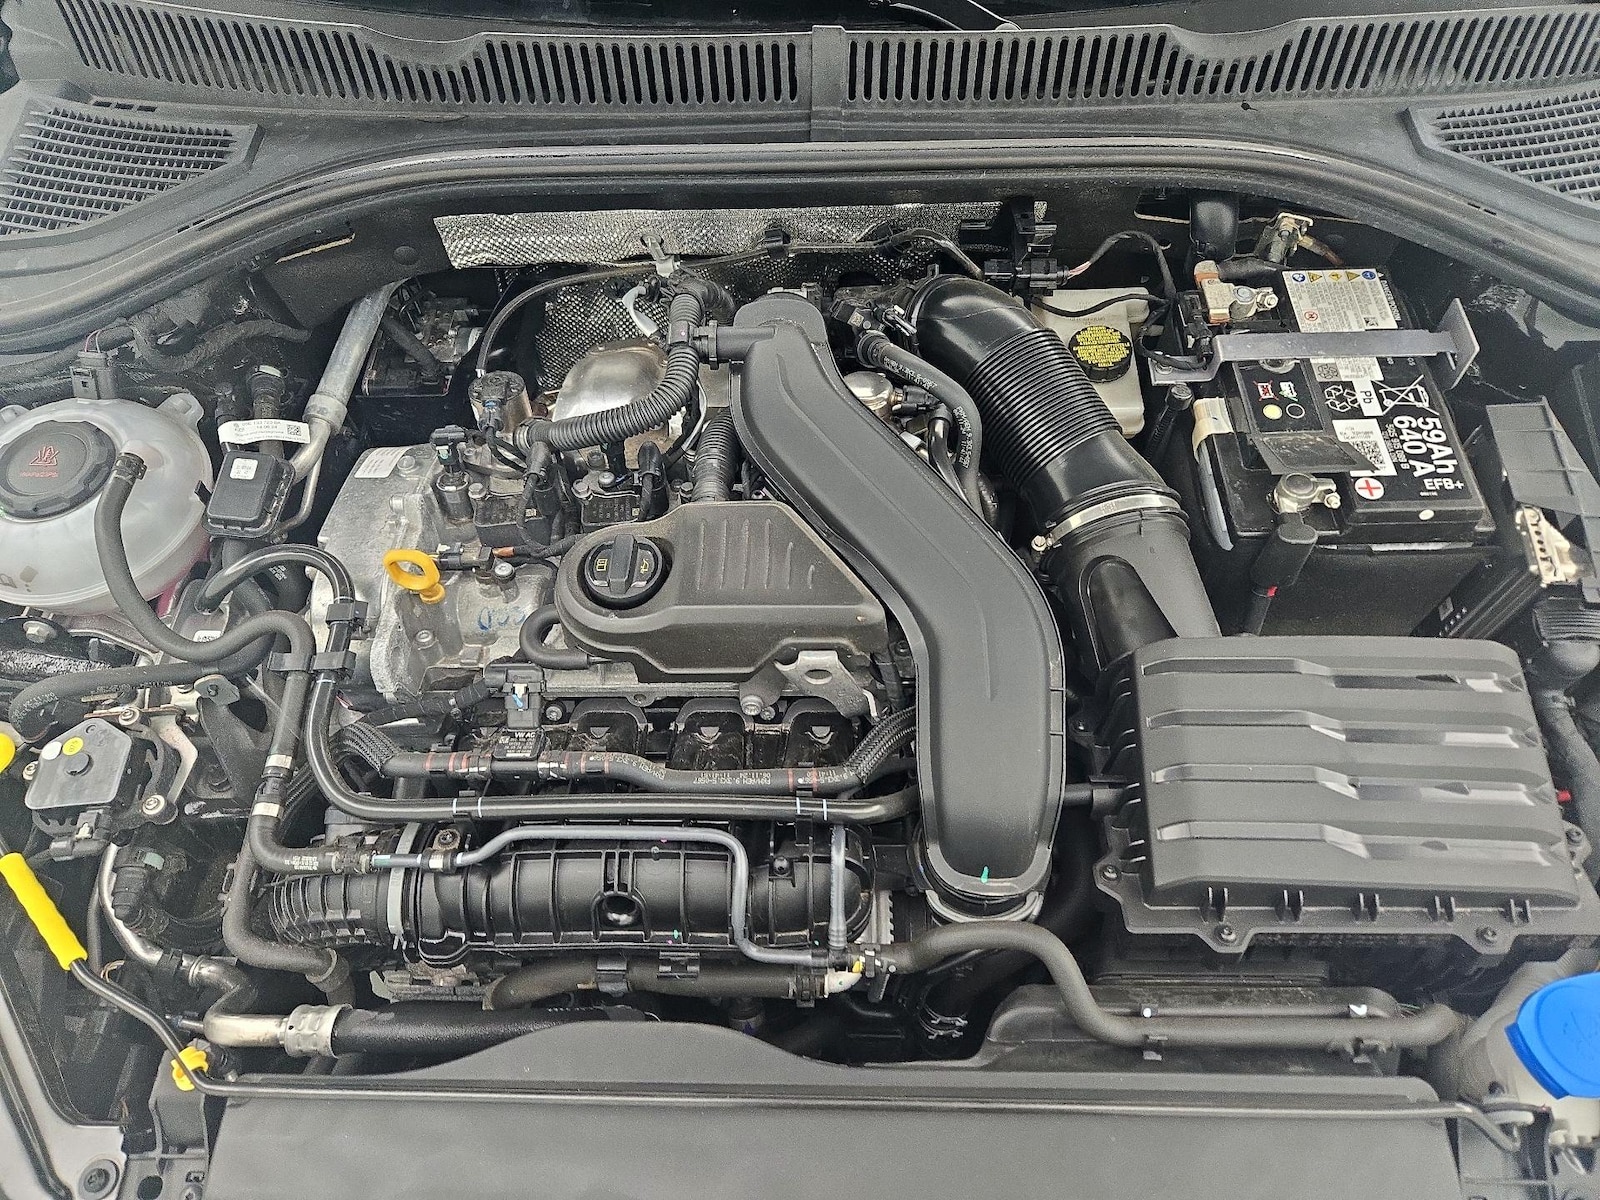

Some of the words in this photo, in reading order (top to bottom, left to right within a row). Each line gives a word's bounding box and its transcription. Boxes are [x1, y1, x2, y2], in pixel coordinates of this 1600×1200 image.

[1360, 390, 1373, 404] Pb
[1393, 415, 1428, 455] 640
[1417, 416, 1458, 474] 59Ah
[1408, 459, 1436, 478] A
[1423, 477, 1464, 490] EFB+
